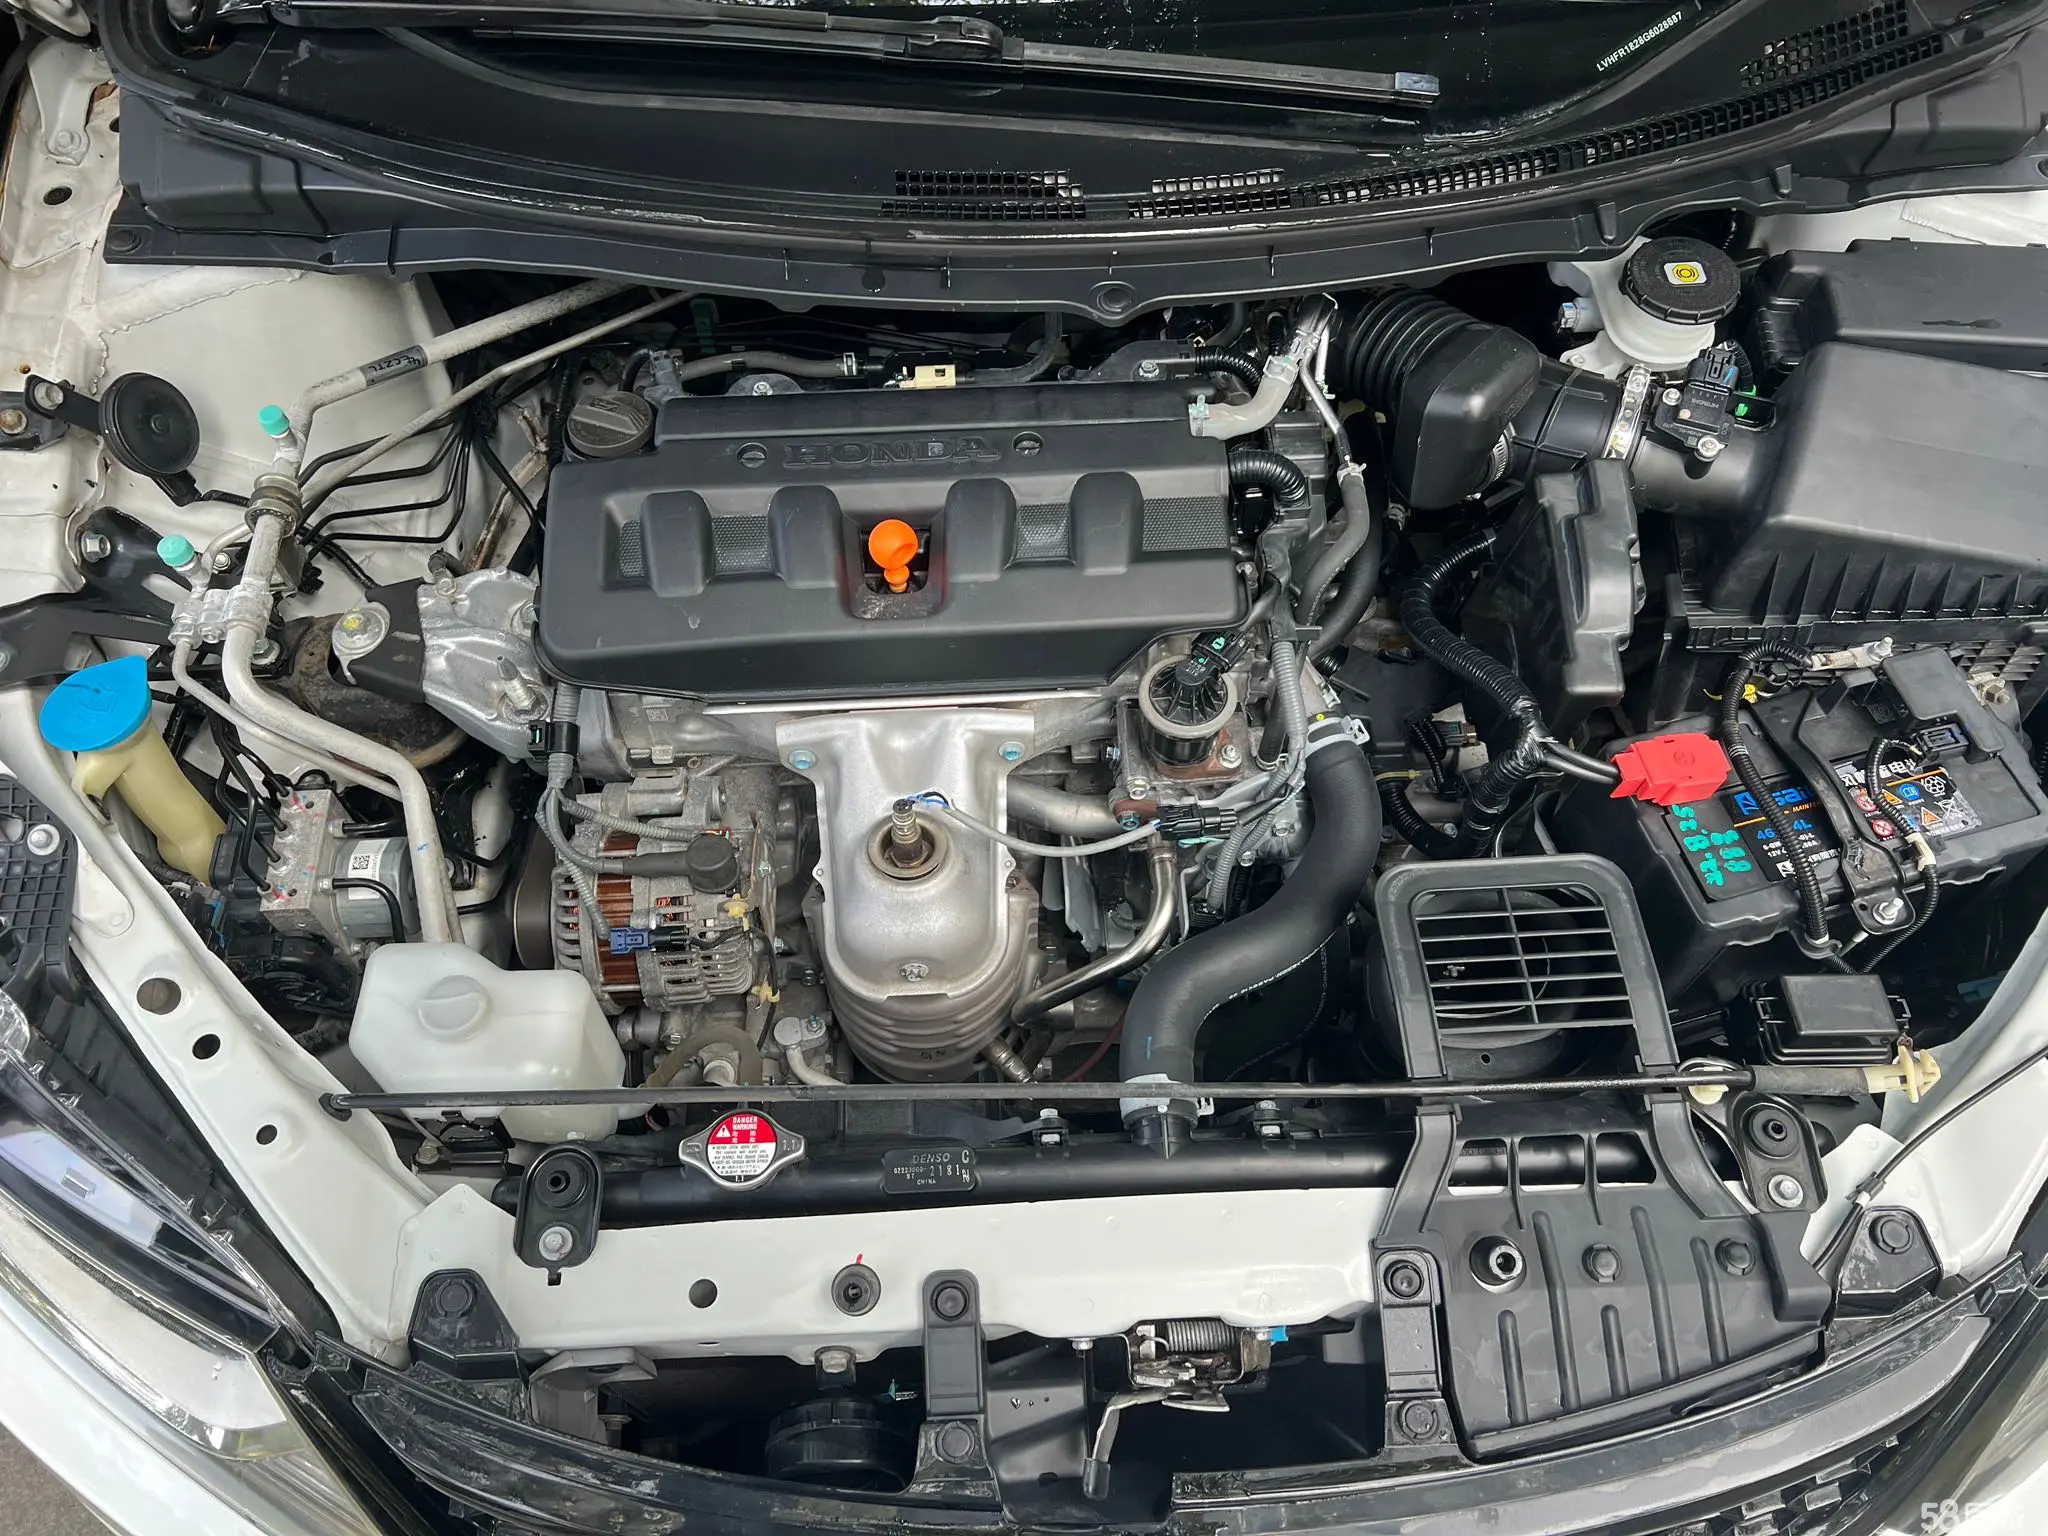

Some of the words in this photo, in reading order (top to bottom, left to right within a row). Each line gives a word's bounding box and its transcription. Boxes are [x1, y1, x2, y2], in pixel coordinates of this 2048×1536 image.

[783, 437, 1001, 468] HONDA
[732, 1116, 758, 1124] DANGER
[783, 1139, 796, 1151] 1.1
[912, 1152, 951, 1164] DENSO
[916, 1178, 937, 1186] CHINA
